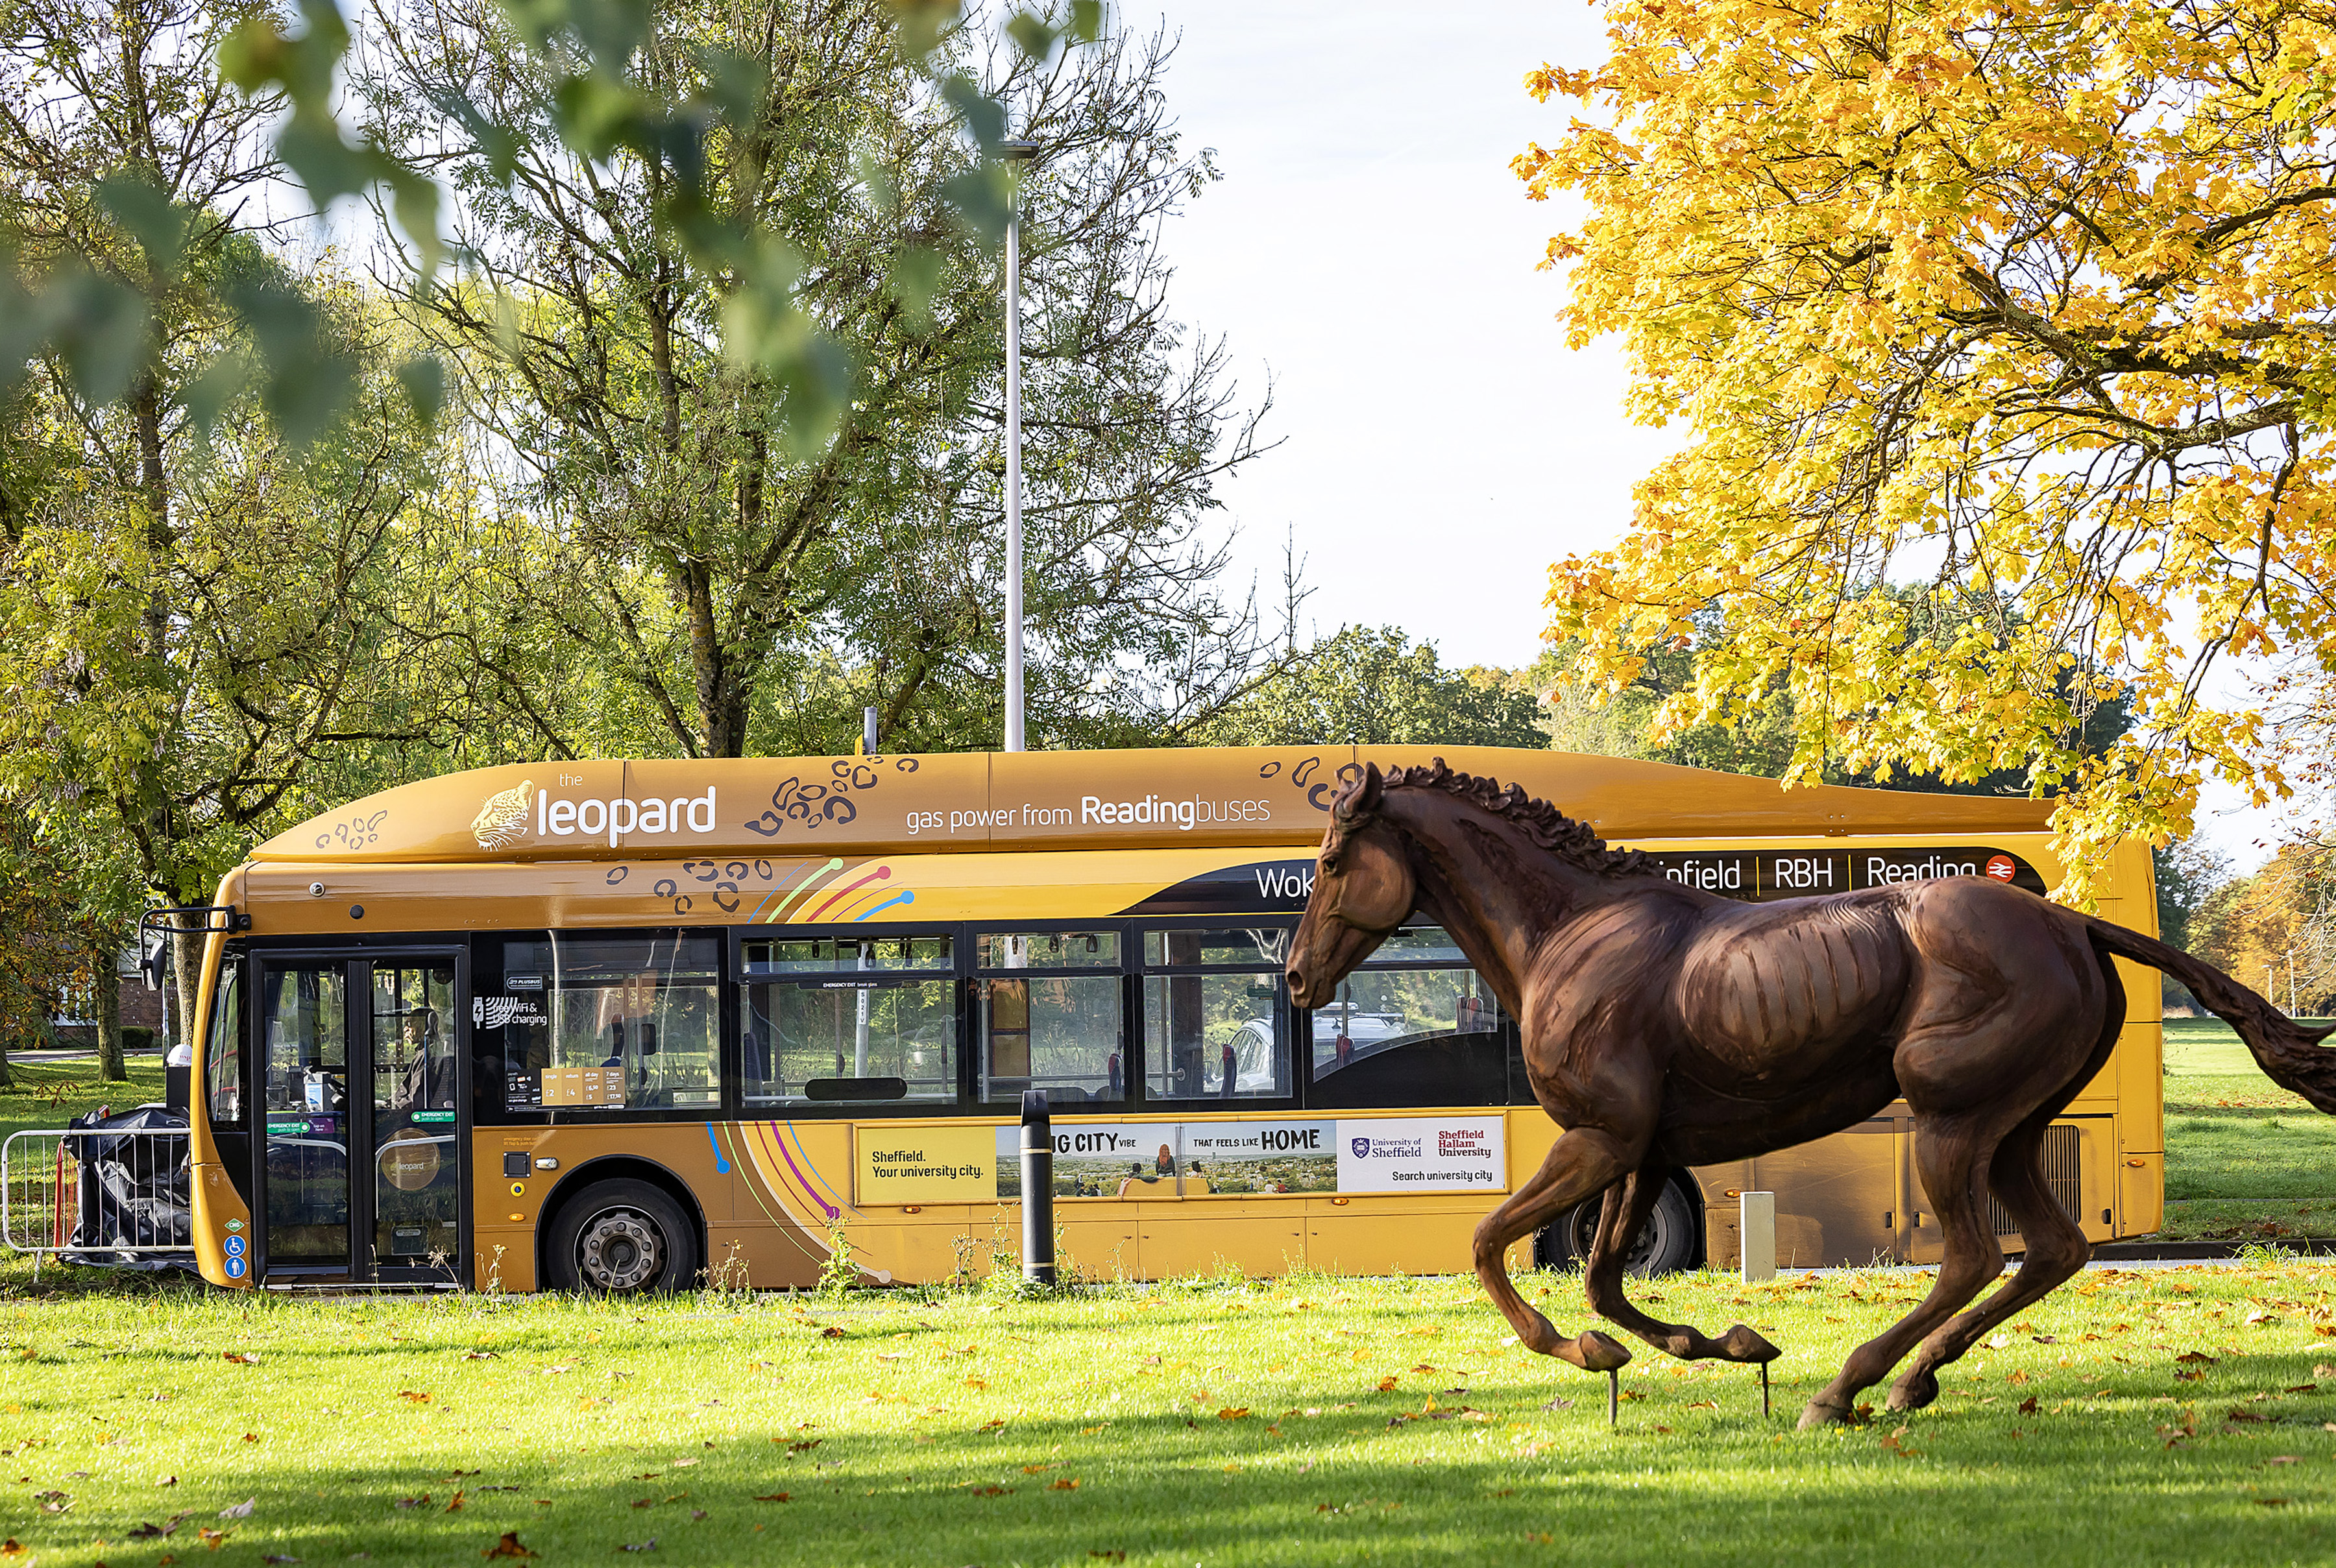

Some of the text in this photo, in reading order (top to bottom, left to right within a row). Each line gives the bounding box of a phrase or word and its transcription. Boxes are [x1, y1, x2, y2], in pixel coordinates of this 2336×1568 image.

[559, 773, 583, 787] the
[537, 785, 716, 849] leopard
[906, 793, 1271, 835] gas power from Readingbuses
[1255, 867, 1316, 898] Wok
[1659, 859, 1740, 889] nfield
[1775, 857, 1832, 888] RBH
[493, 1003, 537, 1013] free WiFi &
[493, 1014, 547, 1026] USB charging
[1193, 1129, 1320, 1151] THAT FEELS LIKE HOME
[1438, 1130, 1485, 1140] Sheffield
[1075, 1132, 1118, 1152] CITY
[1119, 1139, 1136, 1148] VIBE
[1372, 1137, 1422, 1148] University of
[1438, 1140, 1476, 1148] Hallam
[872, 1150, 926, 1163] Sheffield.
[1372, 1147, 1422, 1158] Sheffield
[1438, 1148, 1492, 1159] University
[399, 1162, 424, 1171] leopard
[873, 1164, 984, 1179] Your university city.
[1392, 1170, 1492, 1182] Search university city
